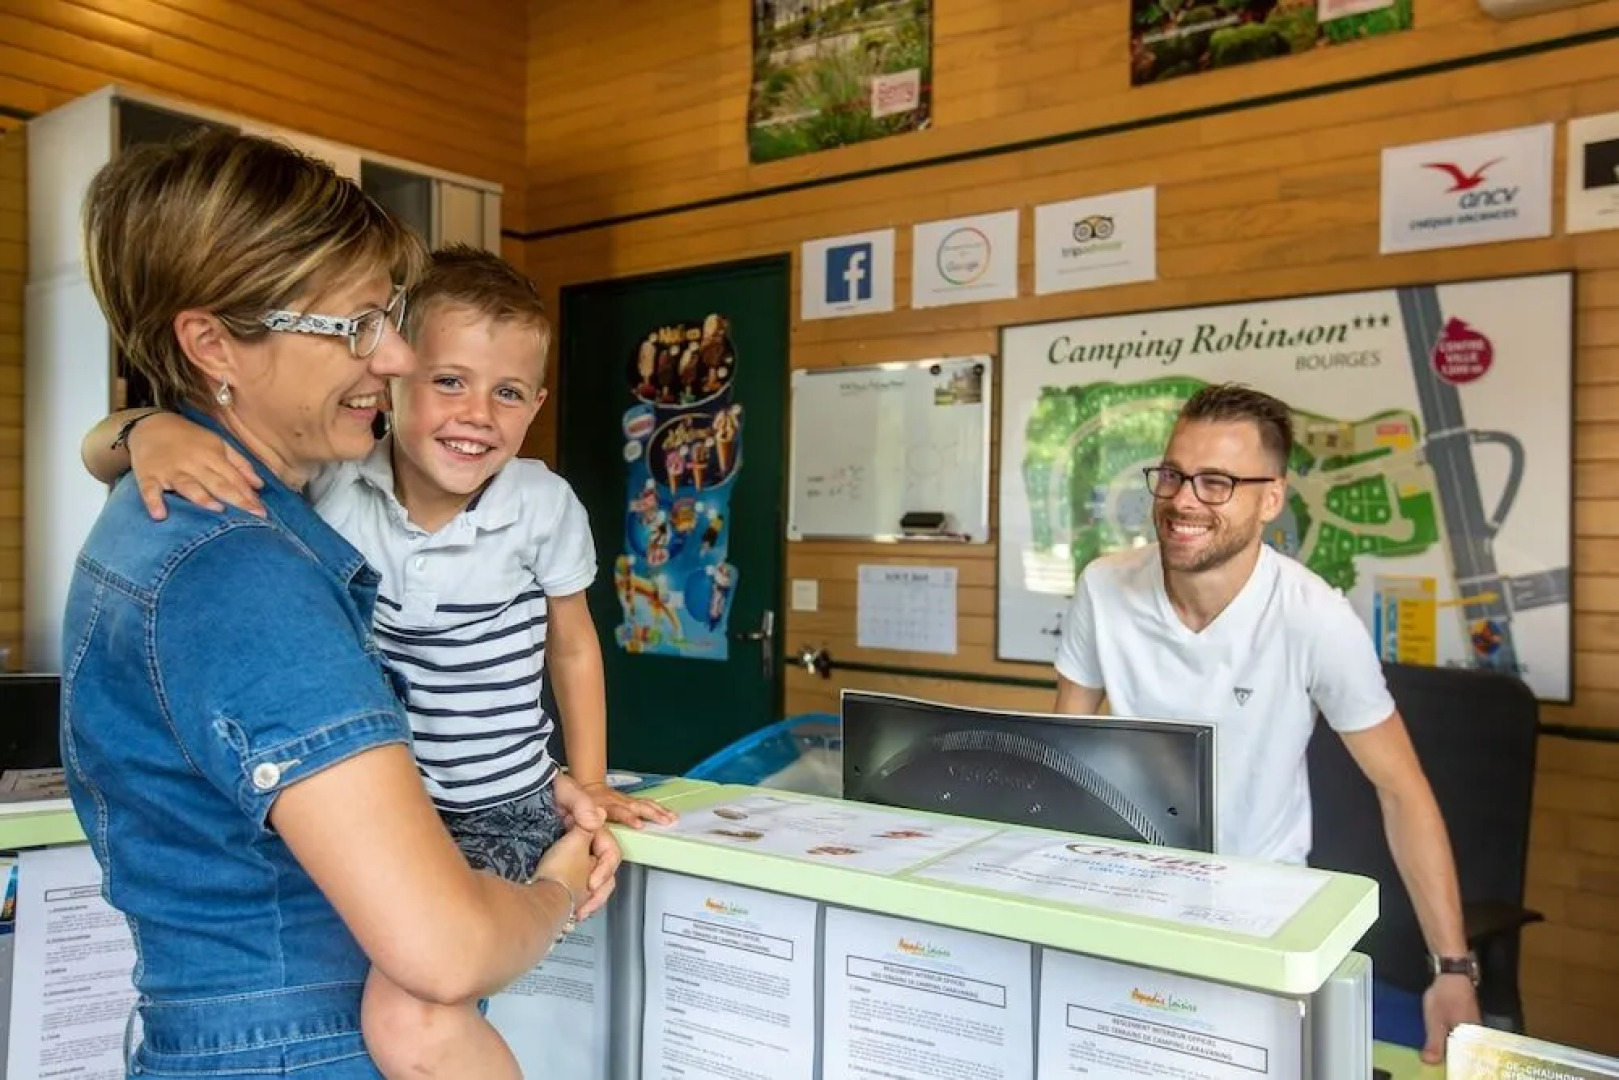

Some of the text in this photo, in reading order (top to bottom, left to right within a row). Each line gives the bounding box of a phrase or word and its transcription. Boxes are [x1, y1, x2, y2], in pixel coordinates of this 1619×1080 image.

[1048, 317, 1348, 369] Camping Robinson
[1295, 350, 1382, 371] BOURGES
